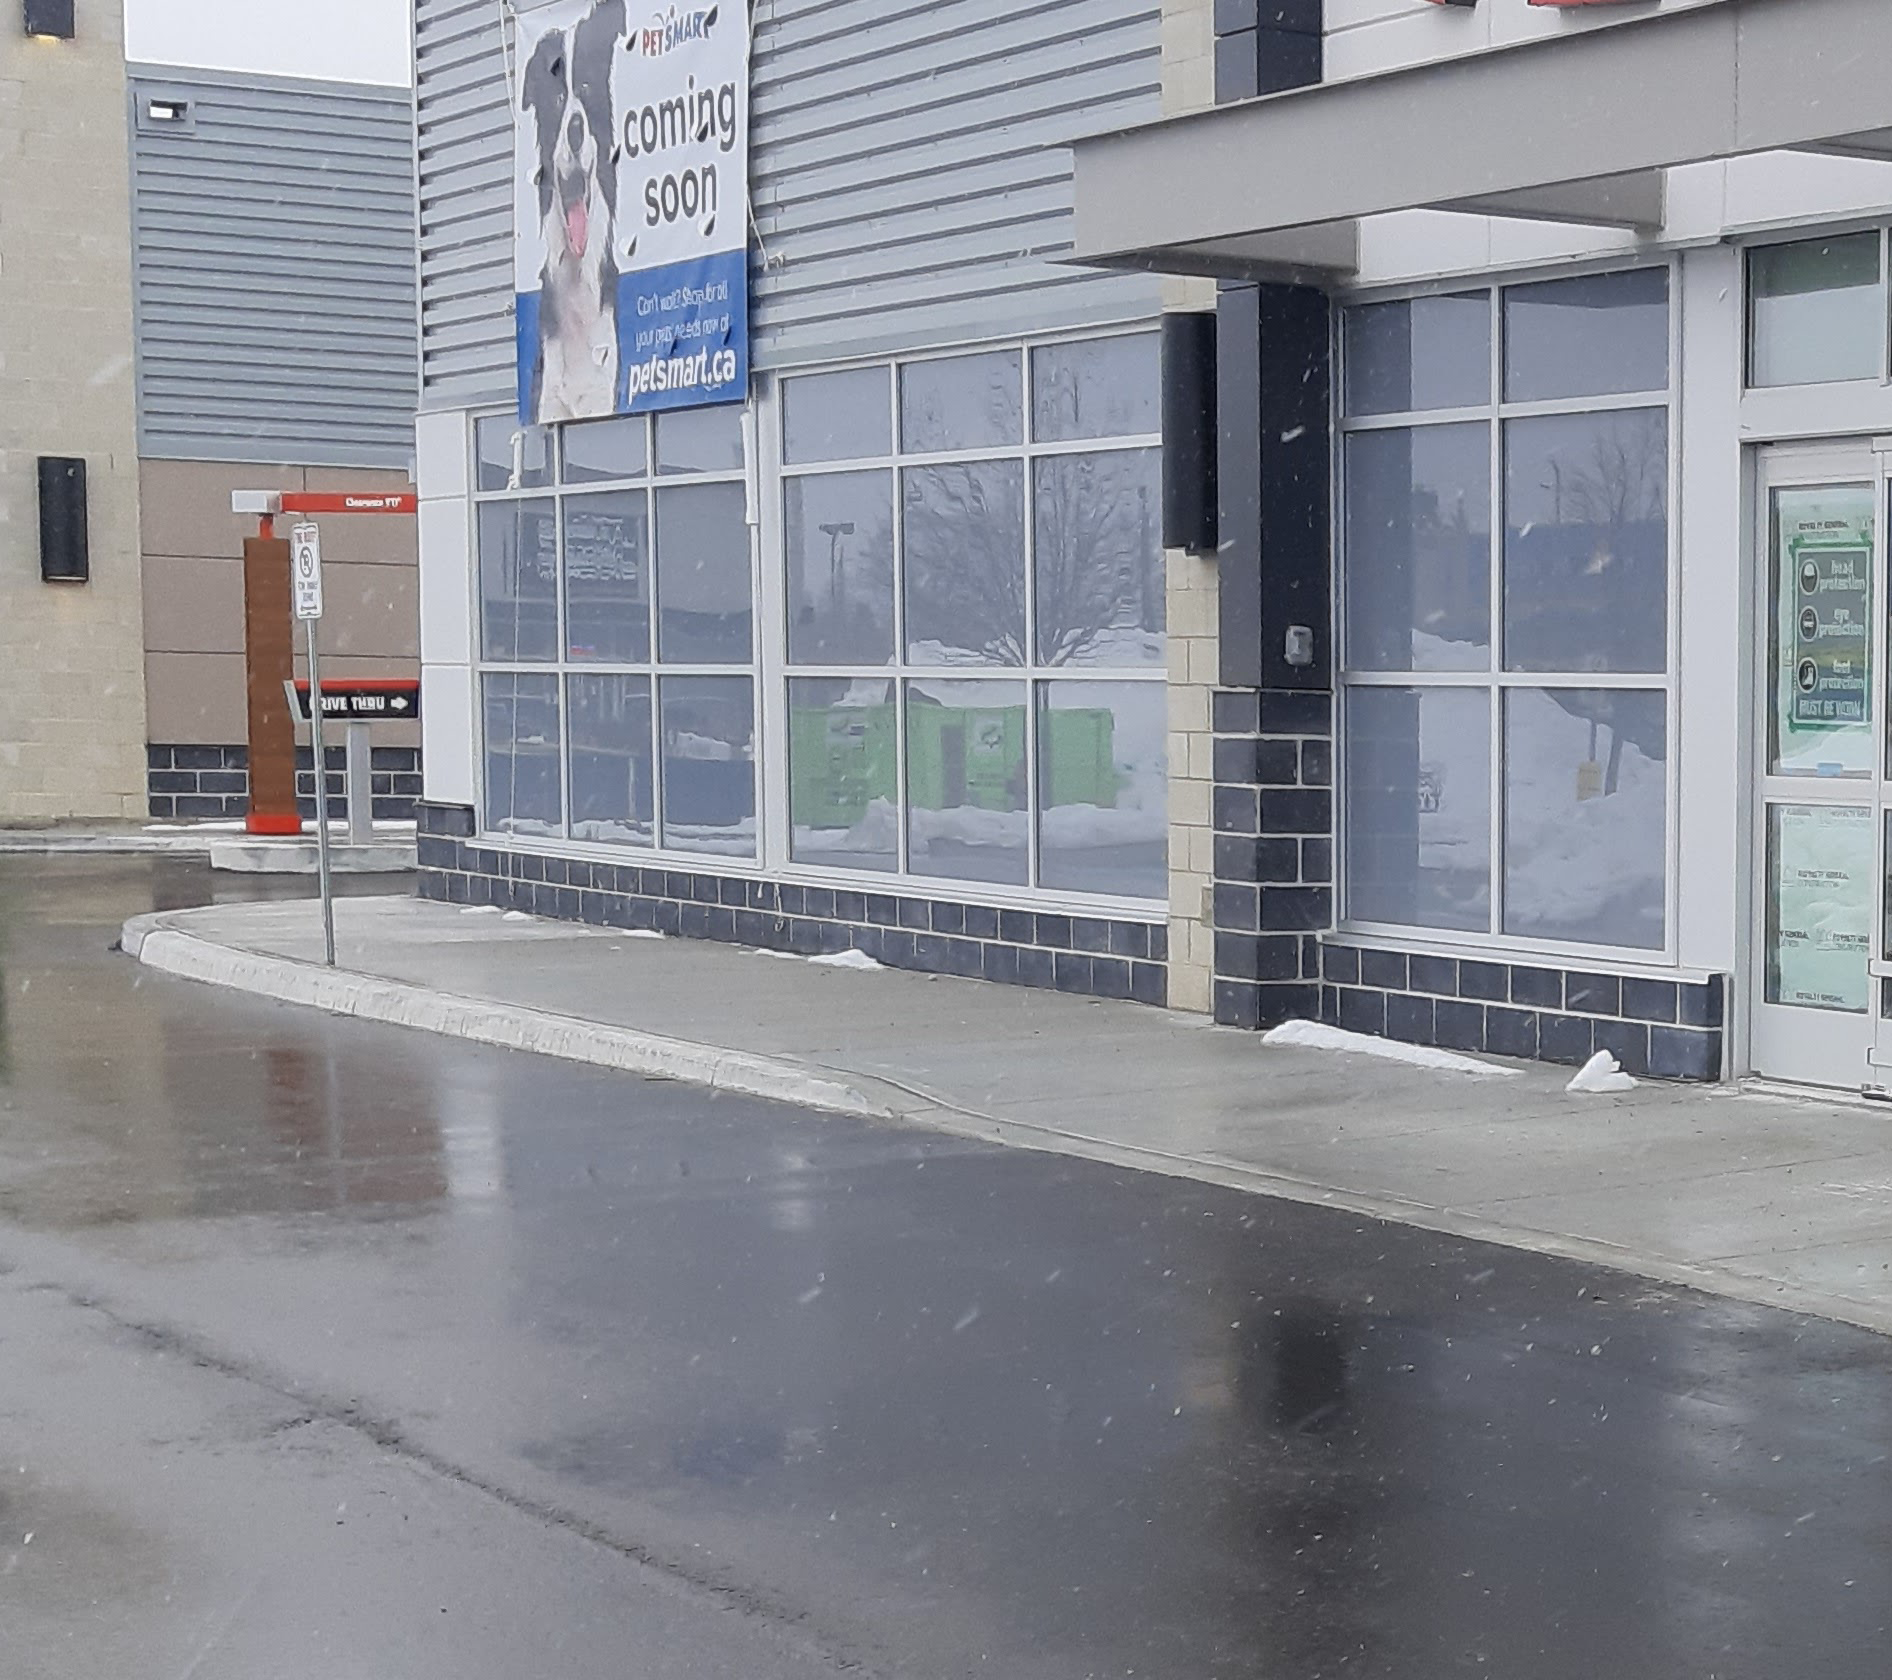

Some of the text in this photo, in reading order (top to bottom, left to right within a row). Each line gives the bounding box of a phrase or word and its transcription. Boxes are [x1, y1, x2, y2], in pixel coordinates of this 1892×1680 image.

[643, 10, 713, 57] PETSMART
[624, 75, 736, 159] coming
[645, 163, 717, 227] soon
[628, 345, 737, 406] petsmart.ca
[309, 695, 385, 711] RIVE THRU
